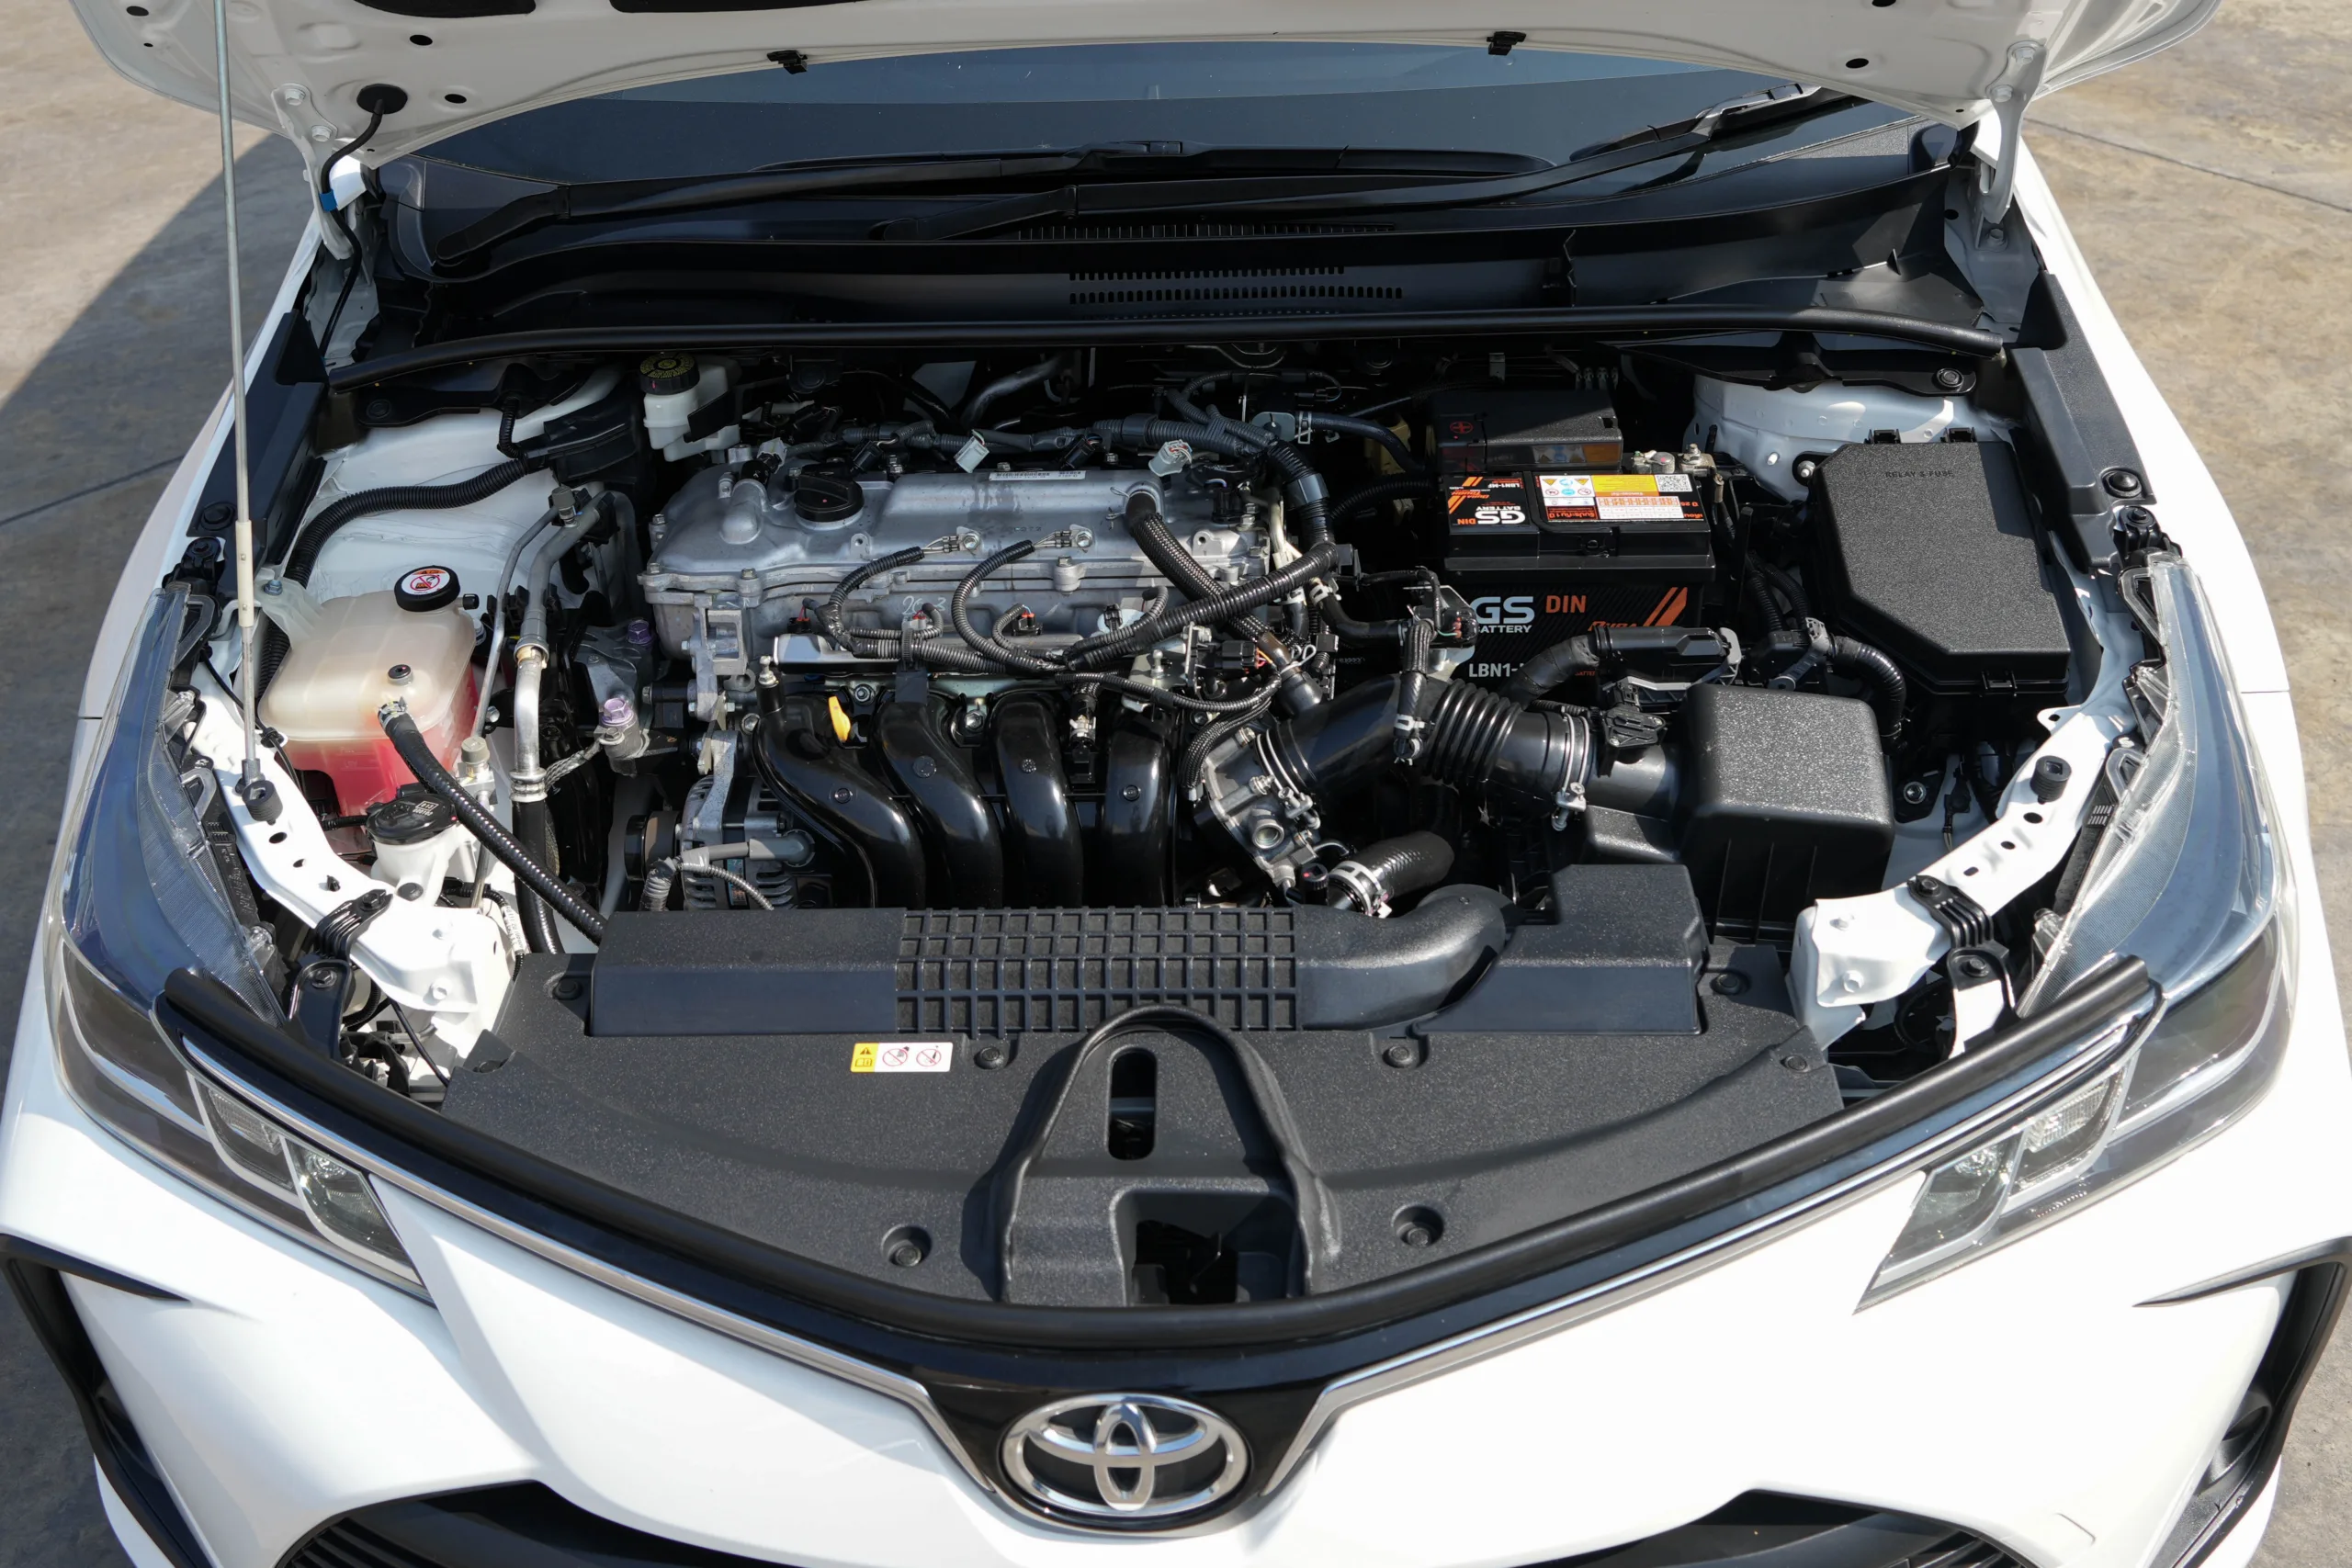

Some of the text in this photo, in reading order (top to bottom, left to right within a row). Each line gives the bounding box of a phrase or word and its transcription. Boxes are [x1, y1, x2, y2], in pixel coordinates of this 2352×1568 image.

[1475, 511, 1525, 524] GS
[1470, 595, 1587, 625] GS DIN
[1477, 625, 1532, 633] ATTERY
[1468, 662, 1524, 678] LBN1-
